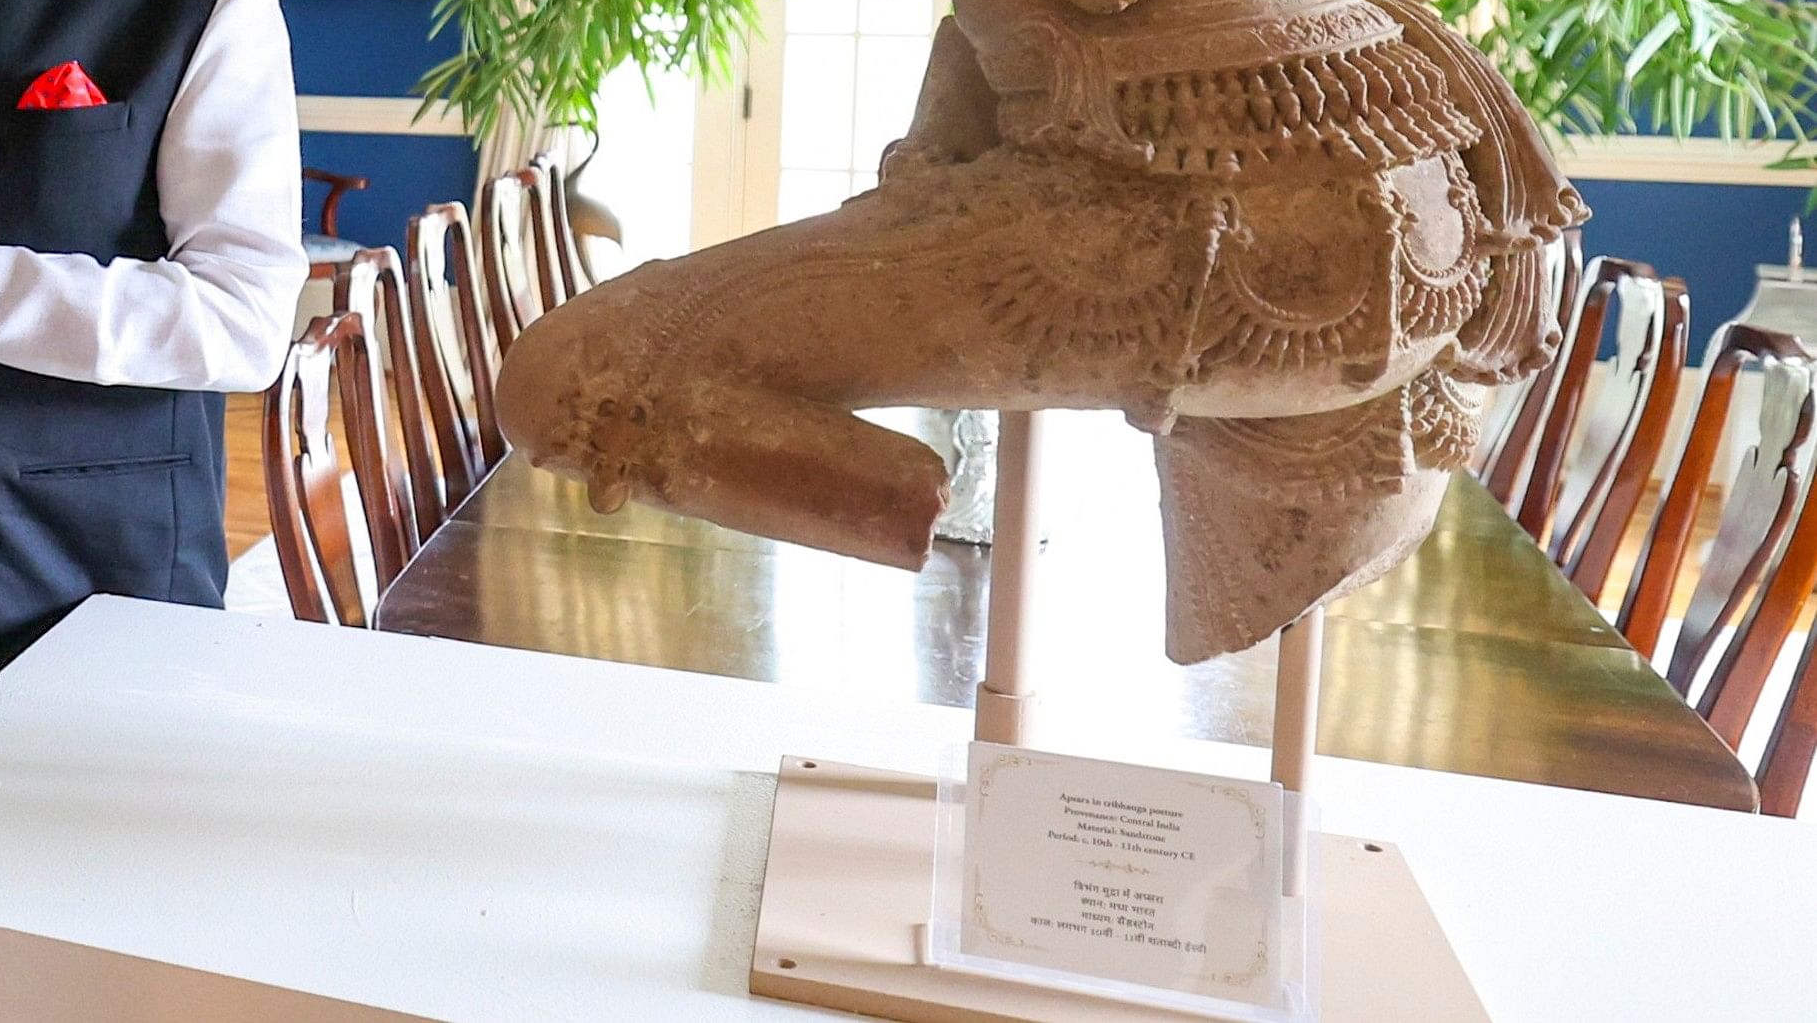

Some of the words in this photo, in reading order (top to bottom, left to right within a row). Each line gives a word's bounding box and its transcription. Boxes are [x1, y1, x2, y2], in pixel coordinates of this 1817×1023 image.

[1092, 798, 1101, 806] in
[1077, 821, 1117, 835] Material:
[1119, 828, 1166, 843] Sandstone
[1119, 815, 1154, 827] Central
[1156, 820, 1180, 832] India
[1092, 837, 1113, 848] 10th
[1121, 842, 1142, 852] 11th
[1143, 847, 1179, 860] century
[1181, 851, 1195, 861] CE
